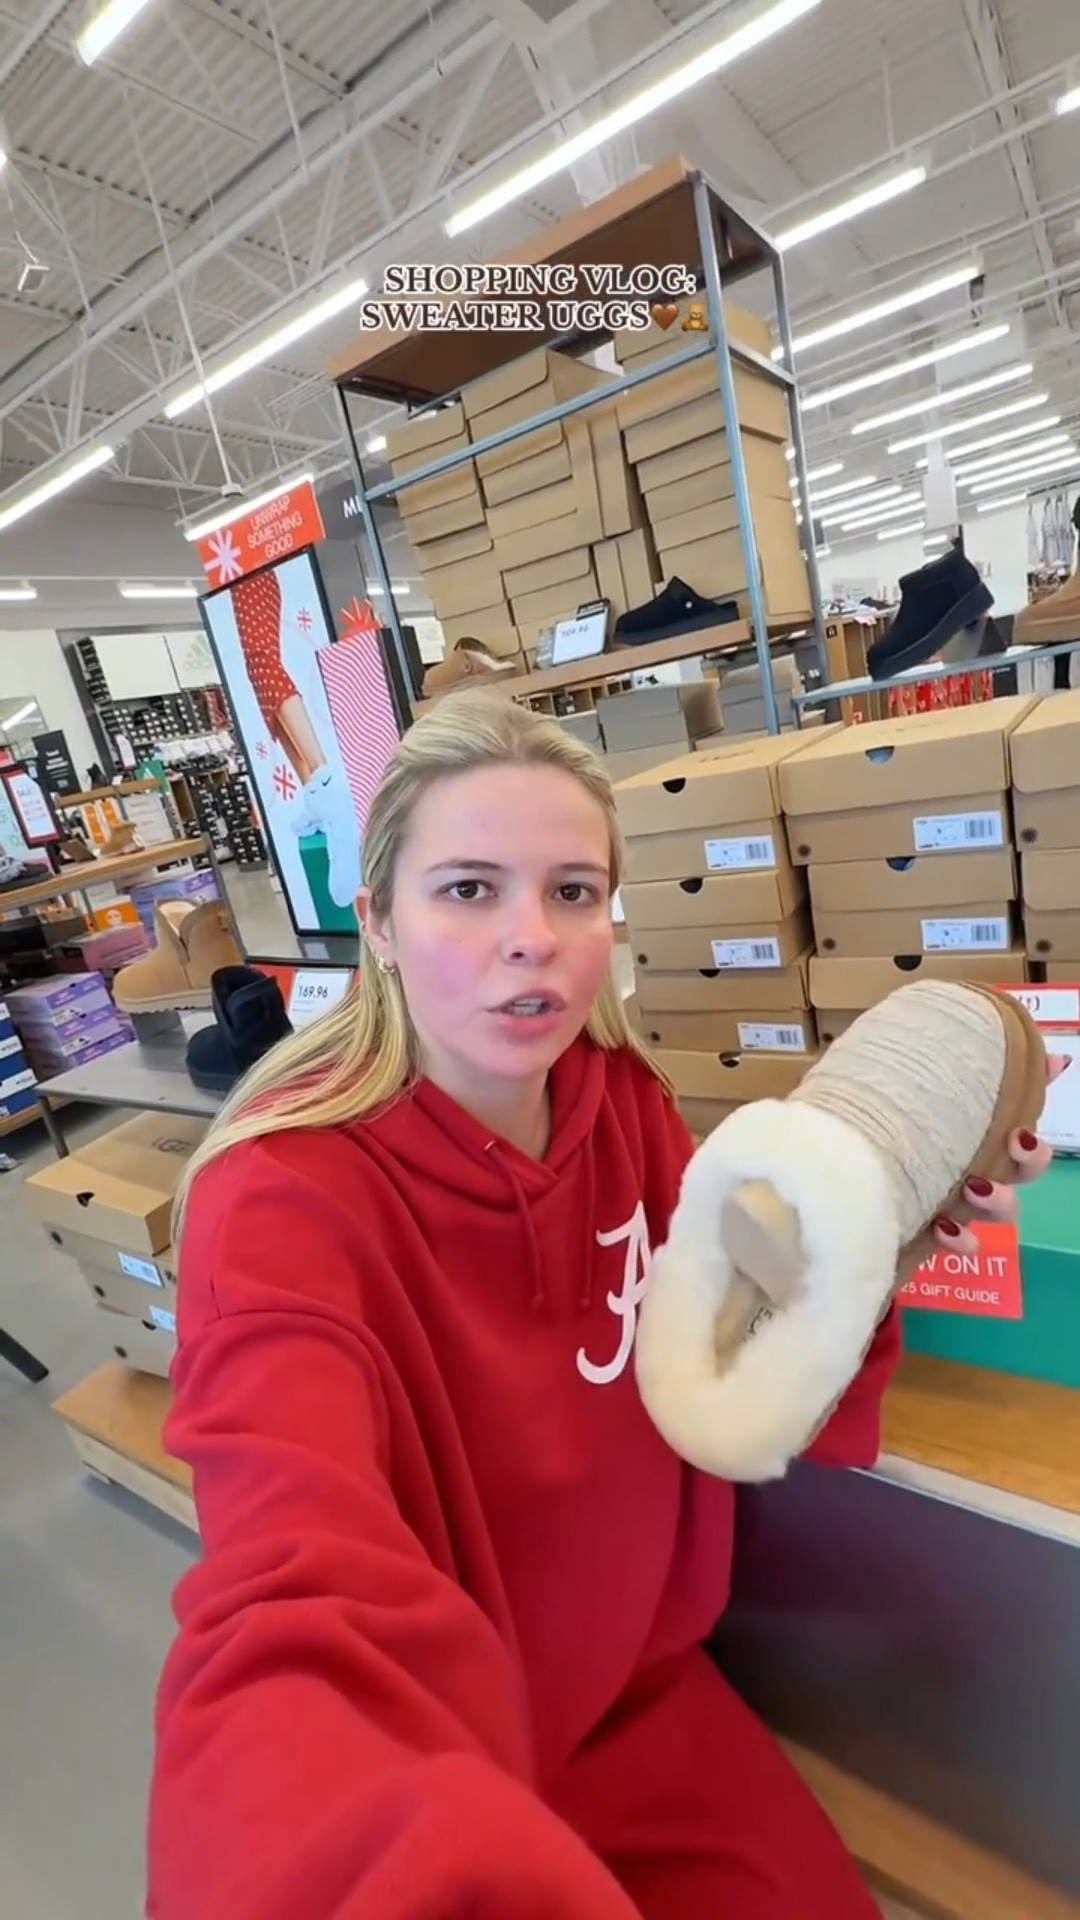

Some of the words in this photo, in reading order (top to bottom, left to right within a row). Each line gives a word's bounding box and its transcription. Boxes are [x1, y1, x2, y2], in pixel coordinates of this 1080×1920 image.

[250, 494, 291, 530] UNWRAP
[247, 510, 303, 549] SOMETHING
[264, 532, 293, 558] GOOD
[298, 985, 329, 999] 169.96
[943, 1254, 980, 1276] ON
[986, 1256, 1008, 1278] IT
[919, 1283, 952, 1298] GIFT
[953, 1288, 1001, 1305] GUIDE
